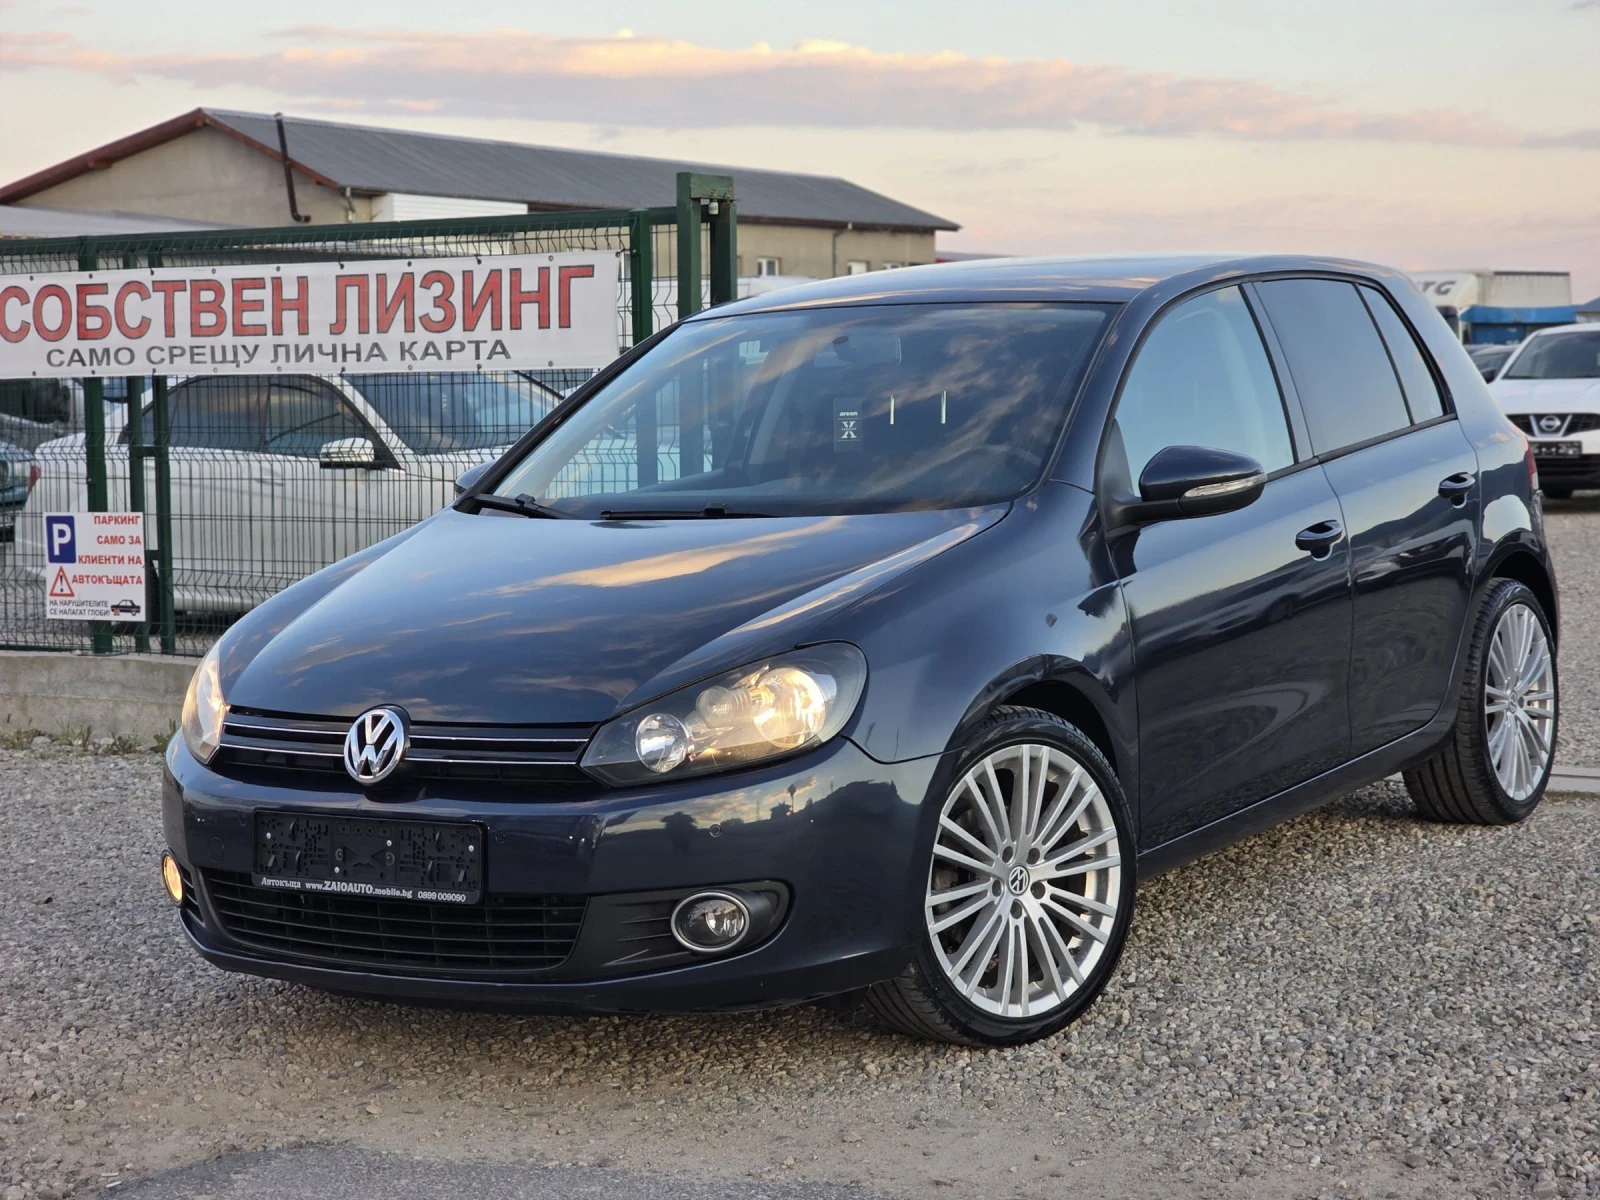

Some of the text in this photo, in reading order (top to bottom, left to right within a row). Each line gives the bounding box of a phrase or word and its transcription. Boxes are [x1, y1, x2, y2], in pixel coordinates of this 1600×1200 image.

[0, 265, 594, 343] СОБСТВЕН ЛИЗИНГ
[46, 339, 512, 368] САМО СРЕЩУ ЛИЧНА КАРТА
[94, 516, 140, 524] ПАРКИНГ
[52, 523, 72, 556] P
[97, 536, 141, 544] САМО ЗА
[78, 556, 142, 564] КЛИЕНТИ НА
[72, 575, 142, 586] АВТОКЪЩАТА
[58, 608, 86, 616] НАЛАГАТ
[261, 877, 301, 889] Автокъща
[417, 890, 437, 900] 0899
